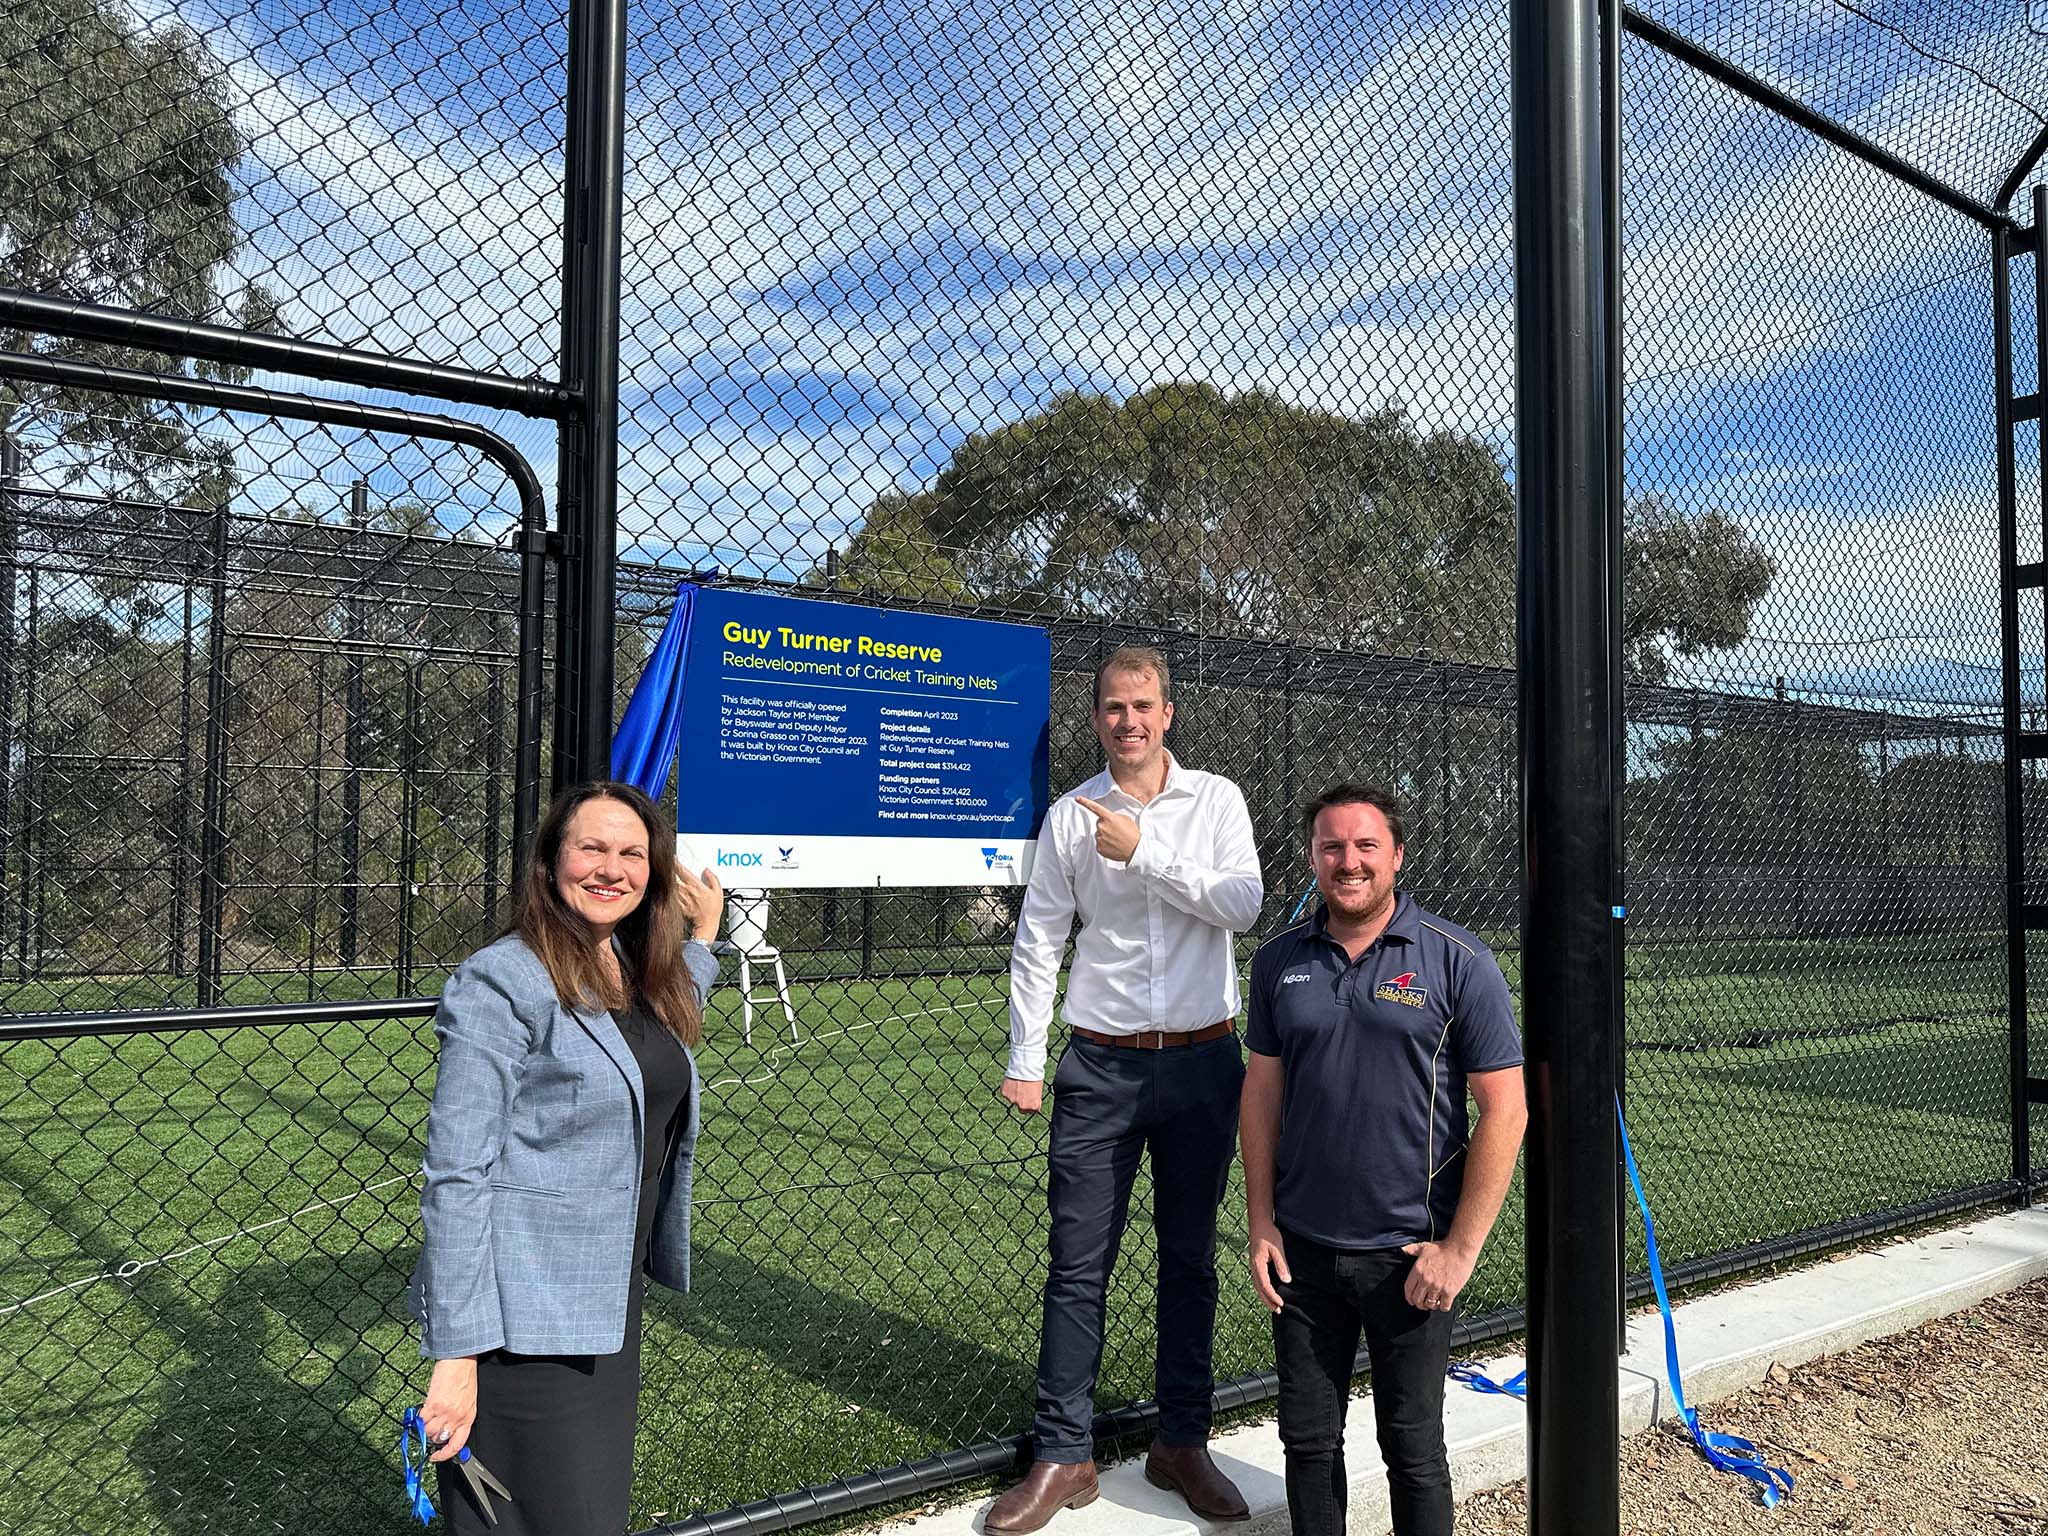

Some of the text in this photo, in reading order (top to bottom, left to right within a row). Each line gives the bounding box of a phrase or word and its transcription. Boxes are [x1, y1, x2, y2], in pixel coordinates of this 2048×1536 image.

[723, 622, 942, 663] Guy Turner Reserve
[723, 652, 997, 691] Redevelopment of Cricket Training Nets
[721, 695, 738, 704] This
[740, 696, 765, 707] facility
[785, 700, 816, 711] officially
[818, 704, 846, 712] opened
[721, 707, 839, 722] by Jackson Taylor MP, Member
[880, 708, 922, 717] Completion
[924, 711, 939, 720] April
[735, 719, 776, 729] Bayswater
[778, 722, 792, 730] and
[795, 723, 822, 733] Deputy
[825, 725, 847, 734] Mayor
[880, 723, 930, 733] Project details
[721, 729, 731, 737] Cr
[733, 730, 758, 739] Sorina
[760, 731, 786, 740] Grasso
[808, 735, 846, 743] December
[849, 737, 868, 745] 2023.
[880, 734, 934, 745] Redevelopment
[944, 738, 967, 746] Cricket
[969, 739, 992, 748] Training
[995, 741, 1009, 749] Nets
[721, 740, 726, 748] It
[747, 742, 763, 750] built
[800, 745, 814, 754] City
[816, 746, 843, 754] Council
[889, 744, 903, 753] Guy
[905, 745, 926, 753] Turner
[928, 747, 954, 755] Reserve
[721, 751, 821, 764] the Victorian Government.
[880, 759, 897, 767] Total
[899, 760, 924, 769] project
[942, 763, 971, 771] $314,422
[880, 775, 939, 785] Funding partners
[899, 787, 912, 795] City
[942, 787, 970, 796] $214,422
[879, 796, 909, 804] Victorian
[955, 798, 987, 806] $100,000
[717, 848, 762, 866] knox
[1379, 985, 1423, 1001] SHARKS
